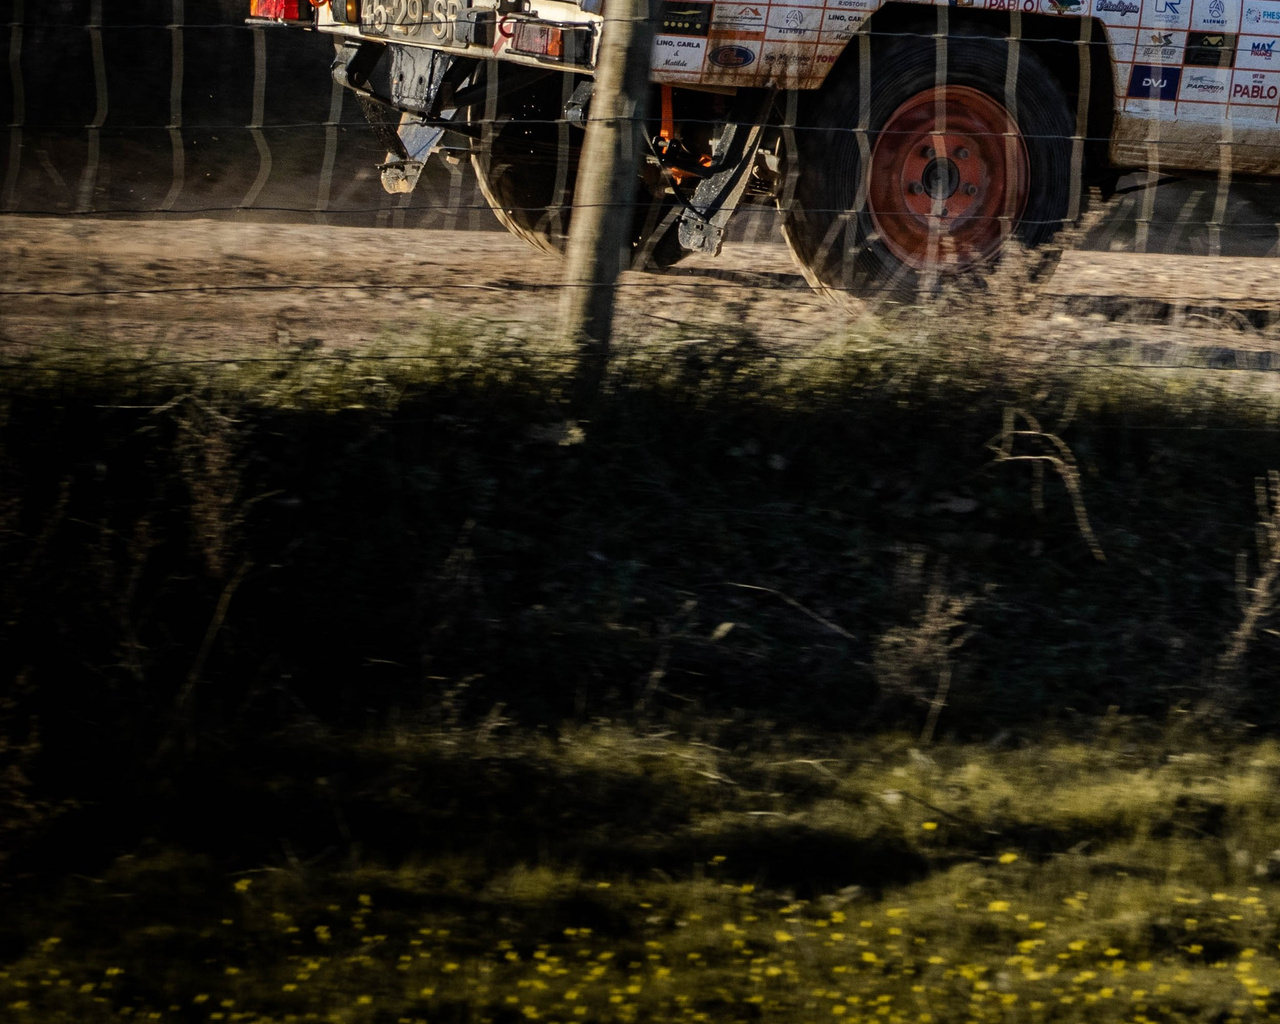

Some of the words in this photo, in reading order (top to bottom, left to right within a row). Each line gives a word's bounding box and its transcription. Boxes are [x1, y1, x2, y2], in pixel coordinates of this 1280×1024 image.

[828, 14, 846, 22] LINO,
[656, 39, 675, 47] LINO,
[677, 41, 701, 49] CARLA
[1252, 41, 1275, 51] MAX
[1142, 78, 1167, 88] DVJ
[1233, 84, 1277, 99] PABLO
